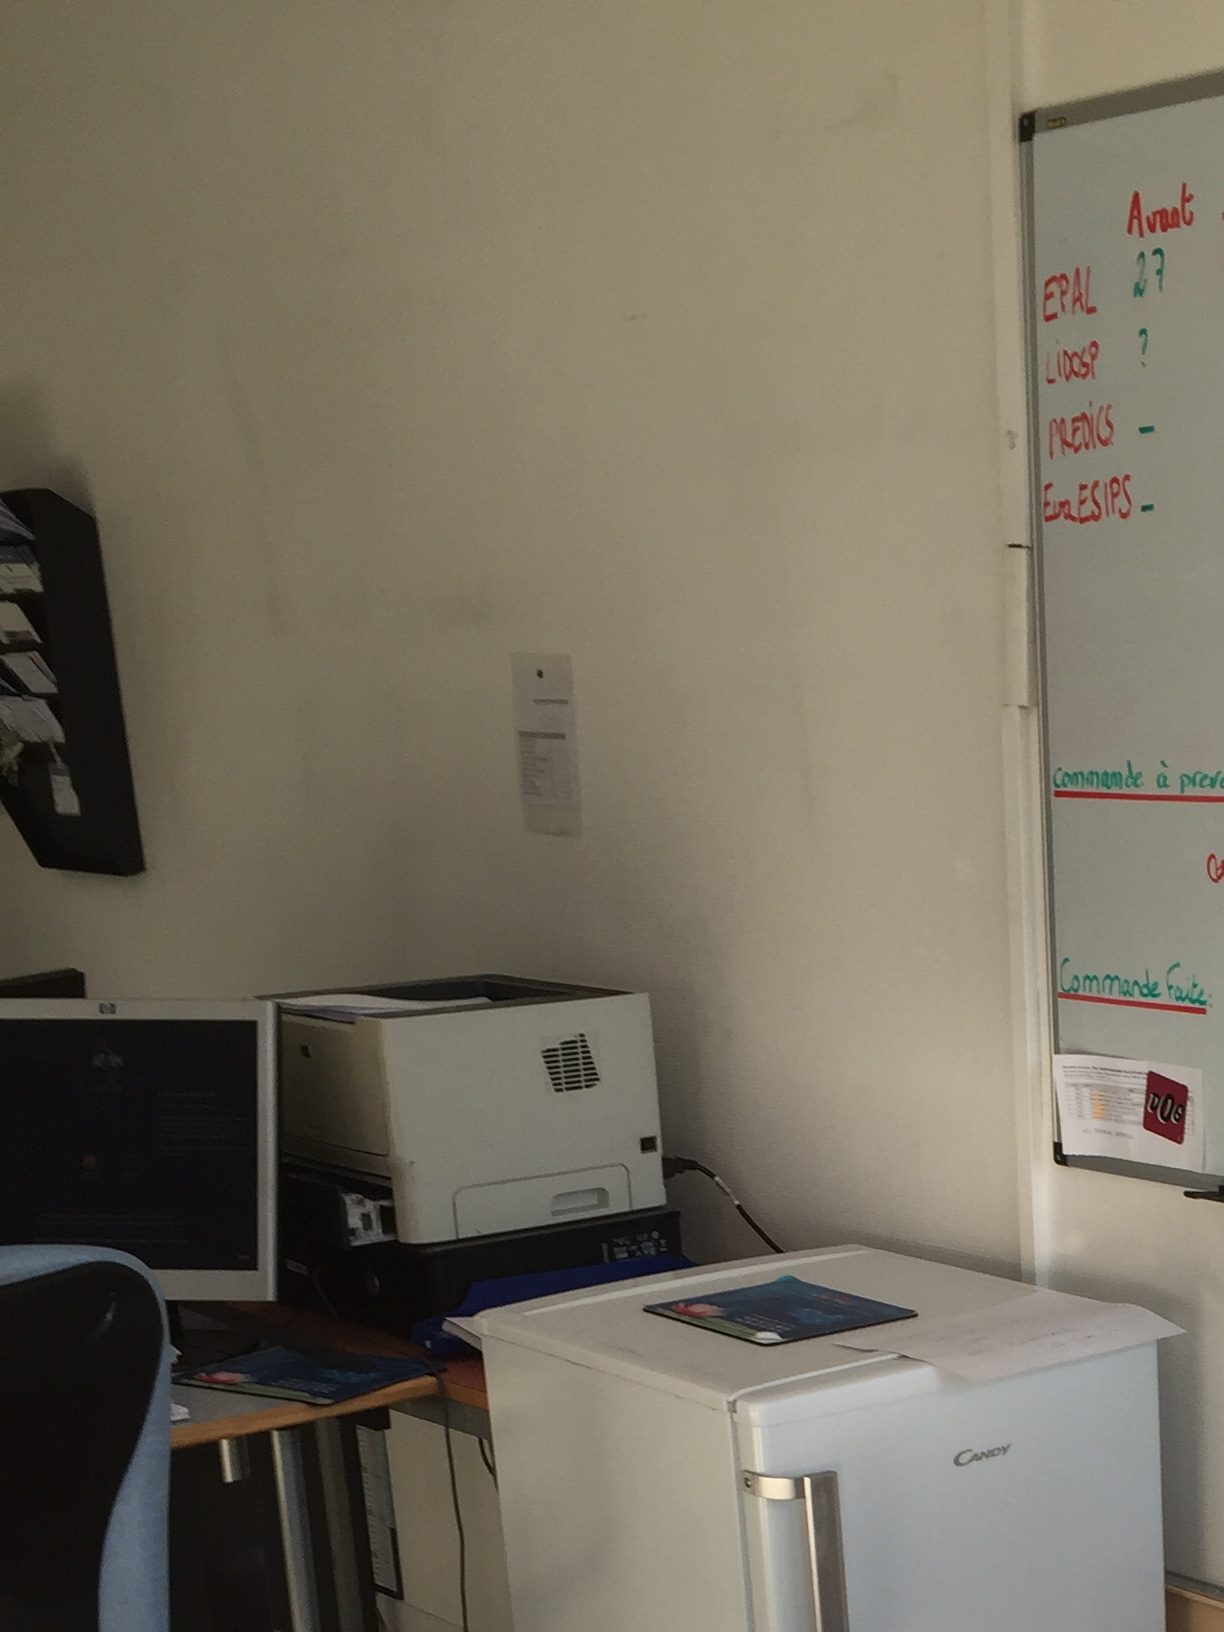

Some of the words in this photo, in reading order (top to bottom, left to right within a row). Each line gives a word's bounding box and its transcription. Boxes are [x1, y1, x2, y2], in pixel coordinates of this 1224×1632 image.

[1127, 184, 1194, 238] Avant
[1043, 267, 1097, 322] EPAL
[1133, 248, 1165, 297] 27
[1156, 759, 1170, 789] à
